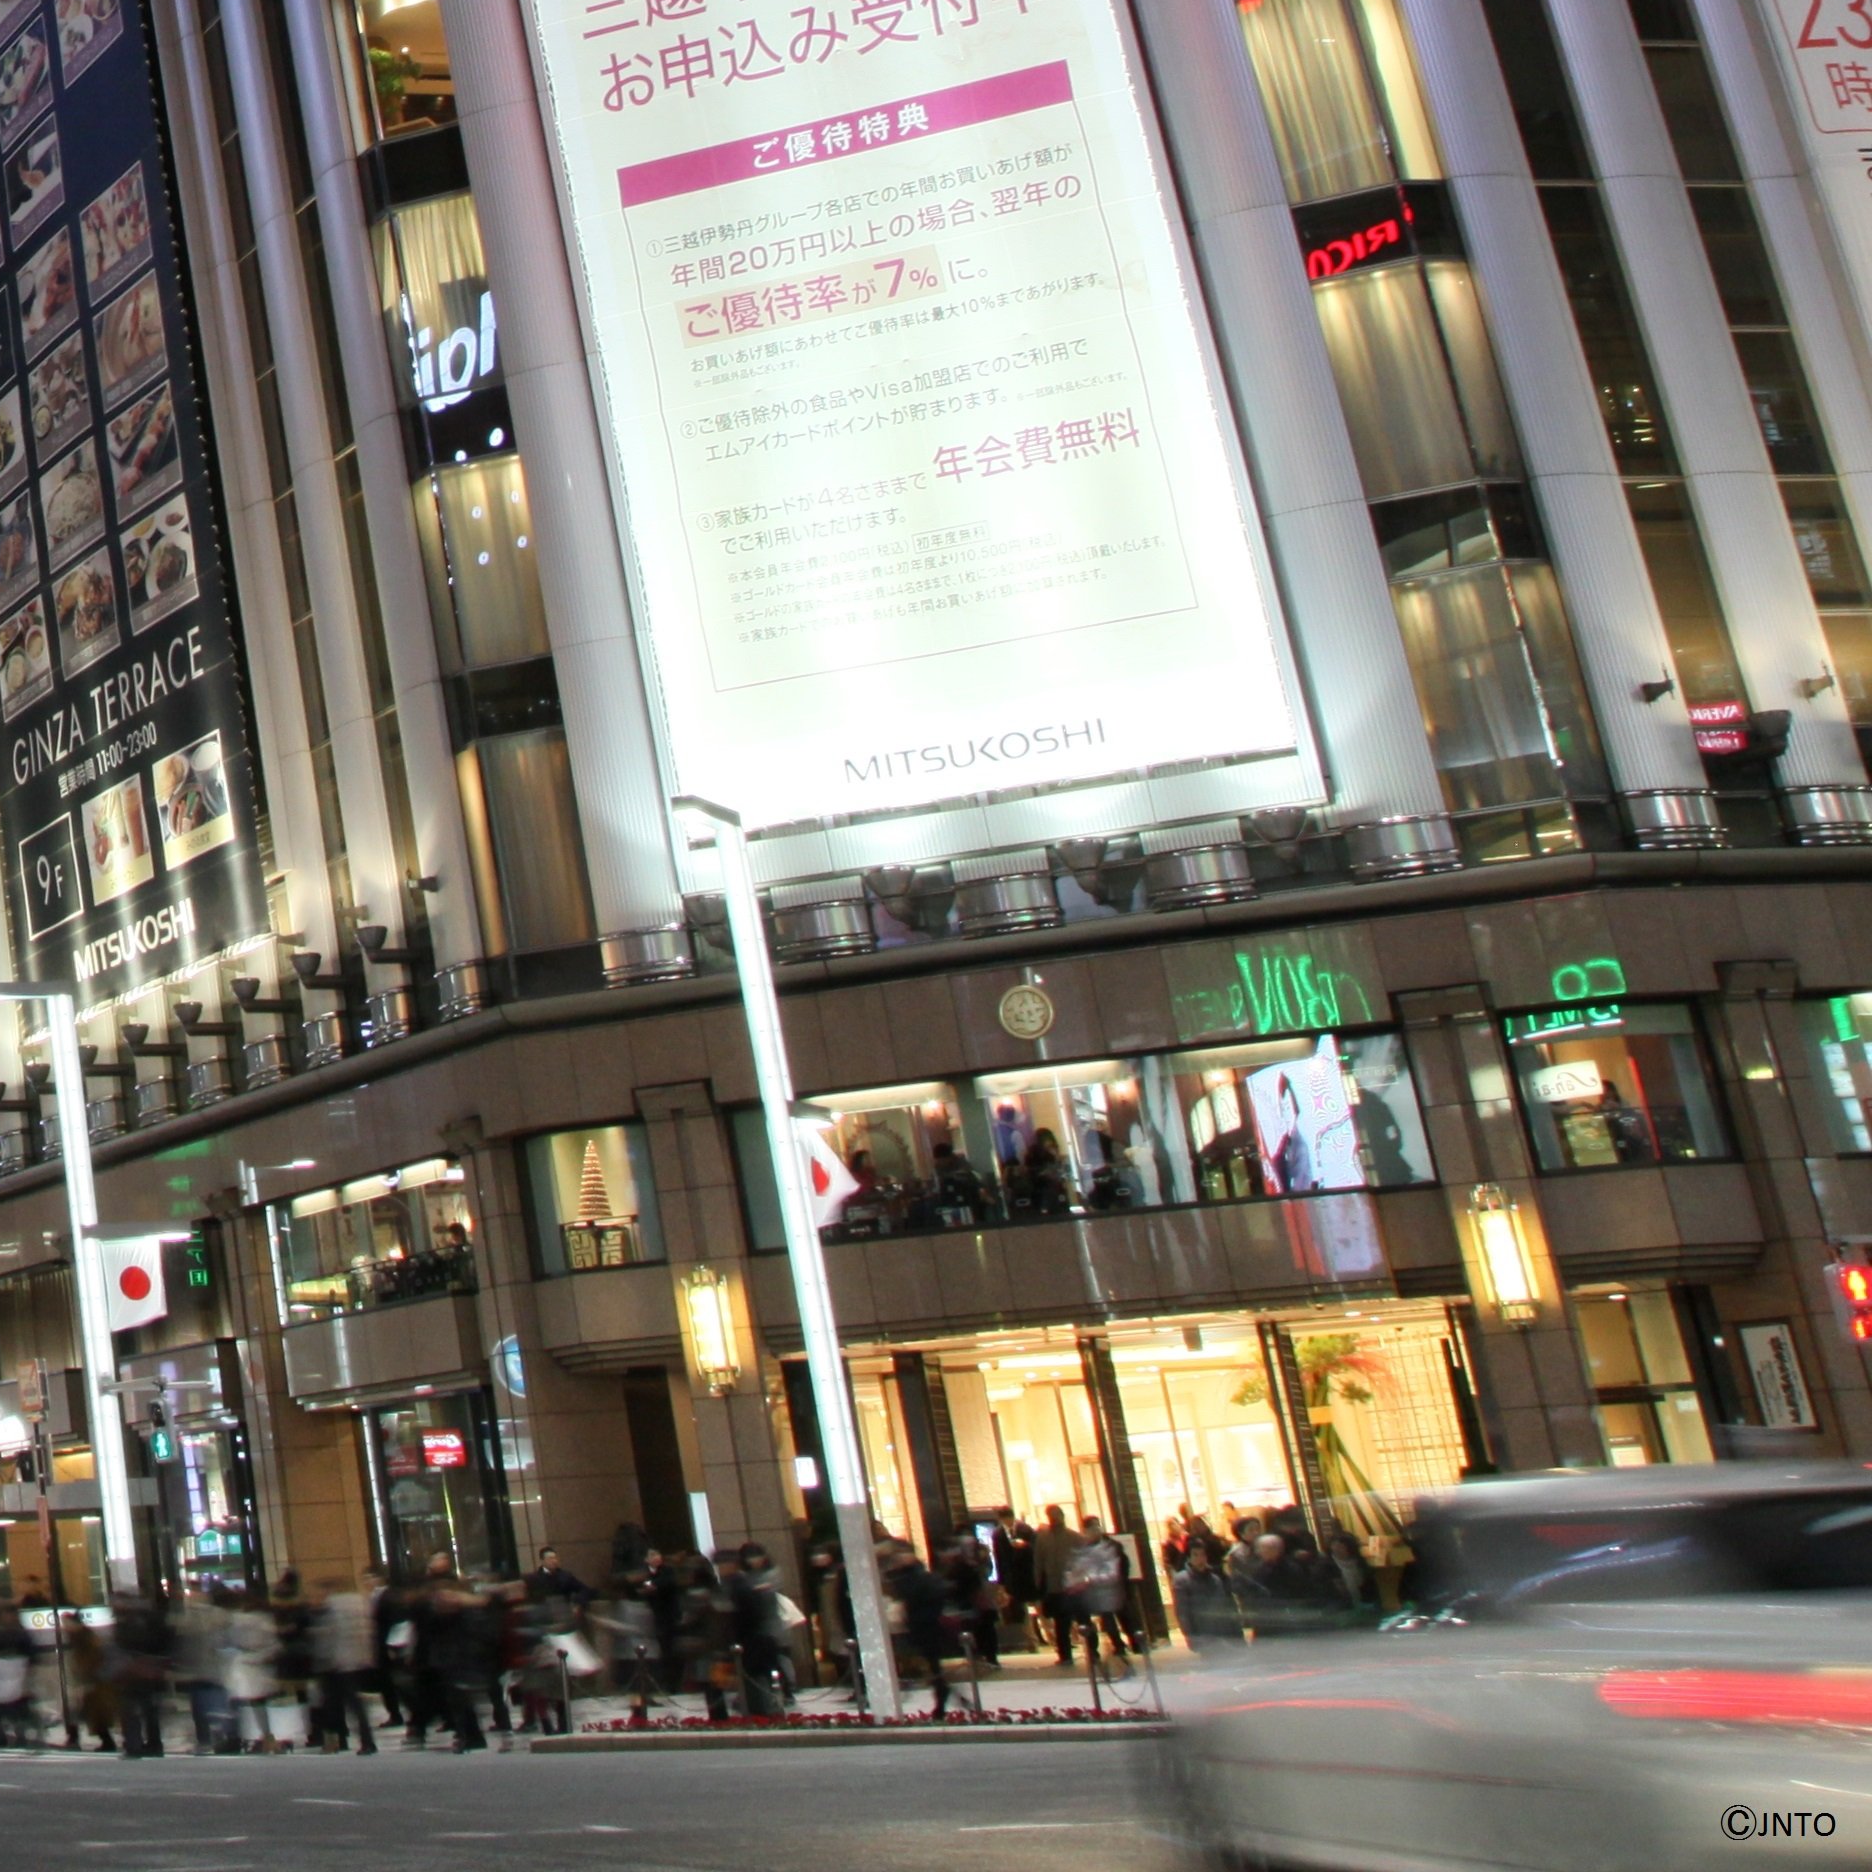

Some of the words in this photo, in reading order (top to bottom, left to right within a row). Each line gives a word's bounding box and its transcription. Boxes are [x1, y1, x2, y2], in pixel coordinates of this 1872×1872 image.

[748, 100, 933, 173] ご優待特典
[927, 406, 1144, 489] 年会費無料
[12, 708, 85, 788] GINZA
[89, 624, 206, 736] TERRACE
[843, 716, 1108, 785] MITSUKOSHI
[73, 897, 196, 983] MITSUKOSHI
